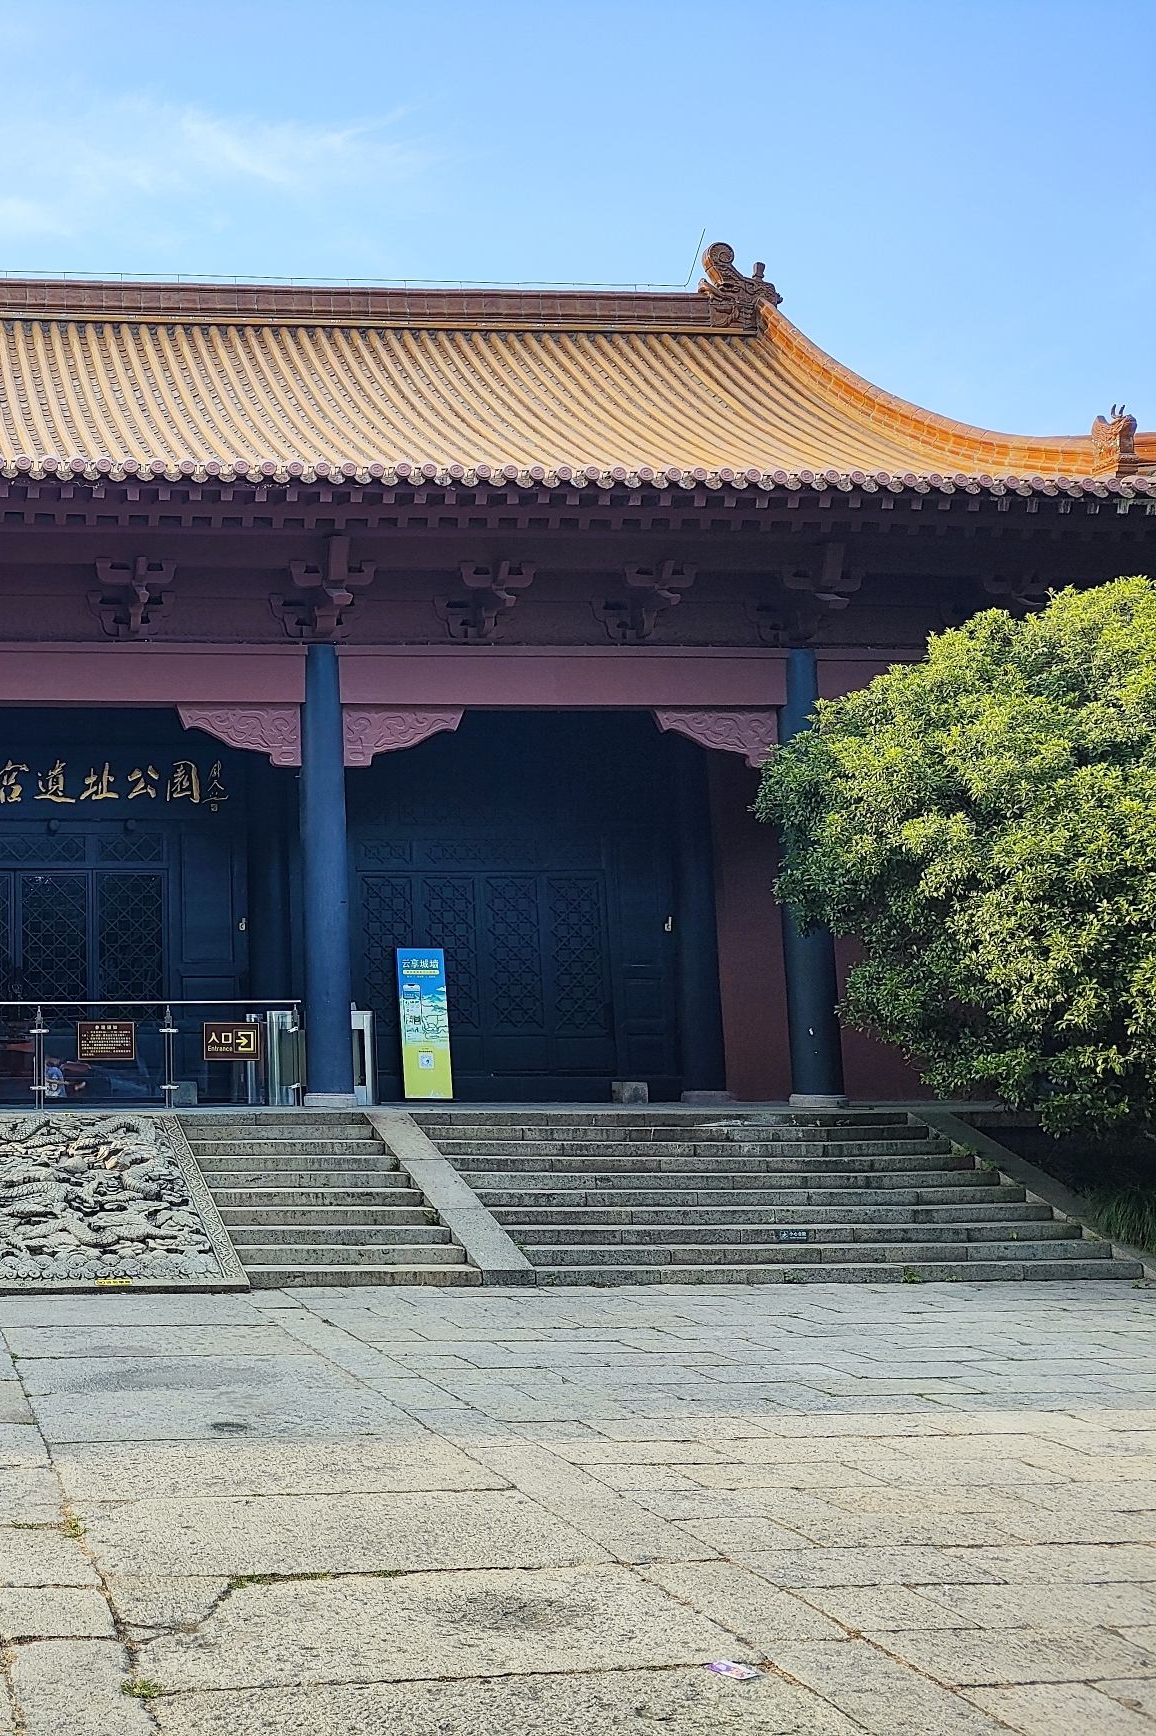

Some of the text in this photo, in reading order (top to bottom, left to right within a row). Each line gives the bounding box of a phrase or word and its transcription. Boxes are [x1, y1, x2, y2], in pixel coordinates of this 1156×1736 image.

[402, 958, 439, 969] 云享城墙
[207, 1031, 232, 1044] 入口
